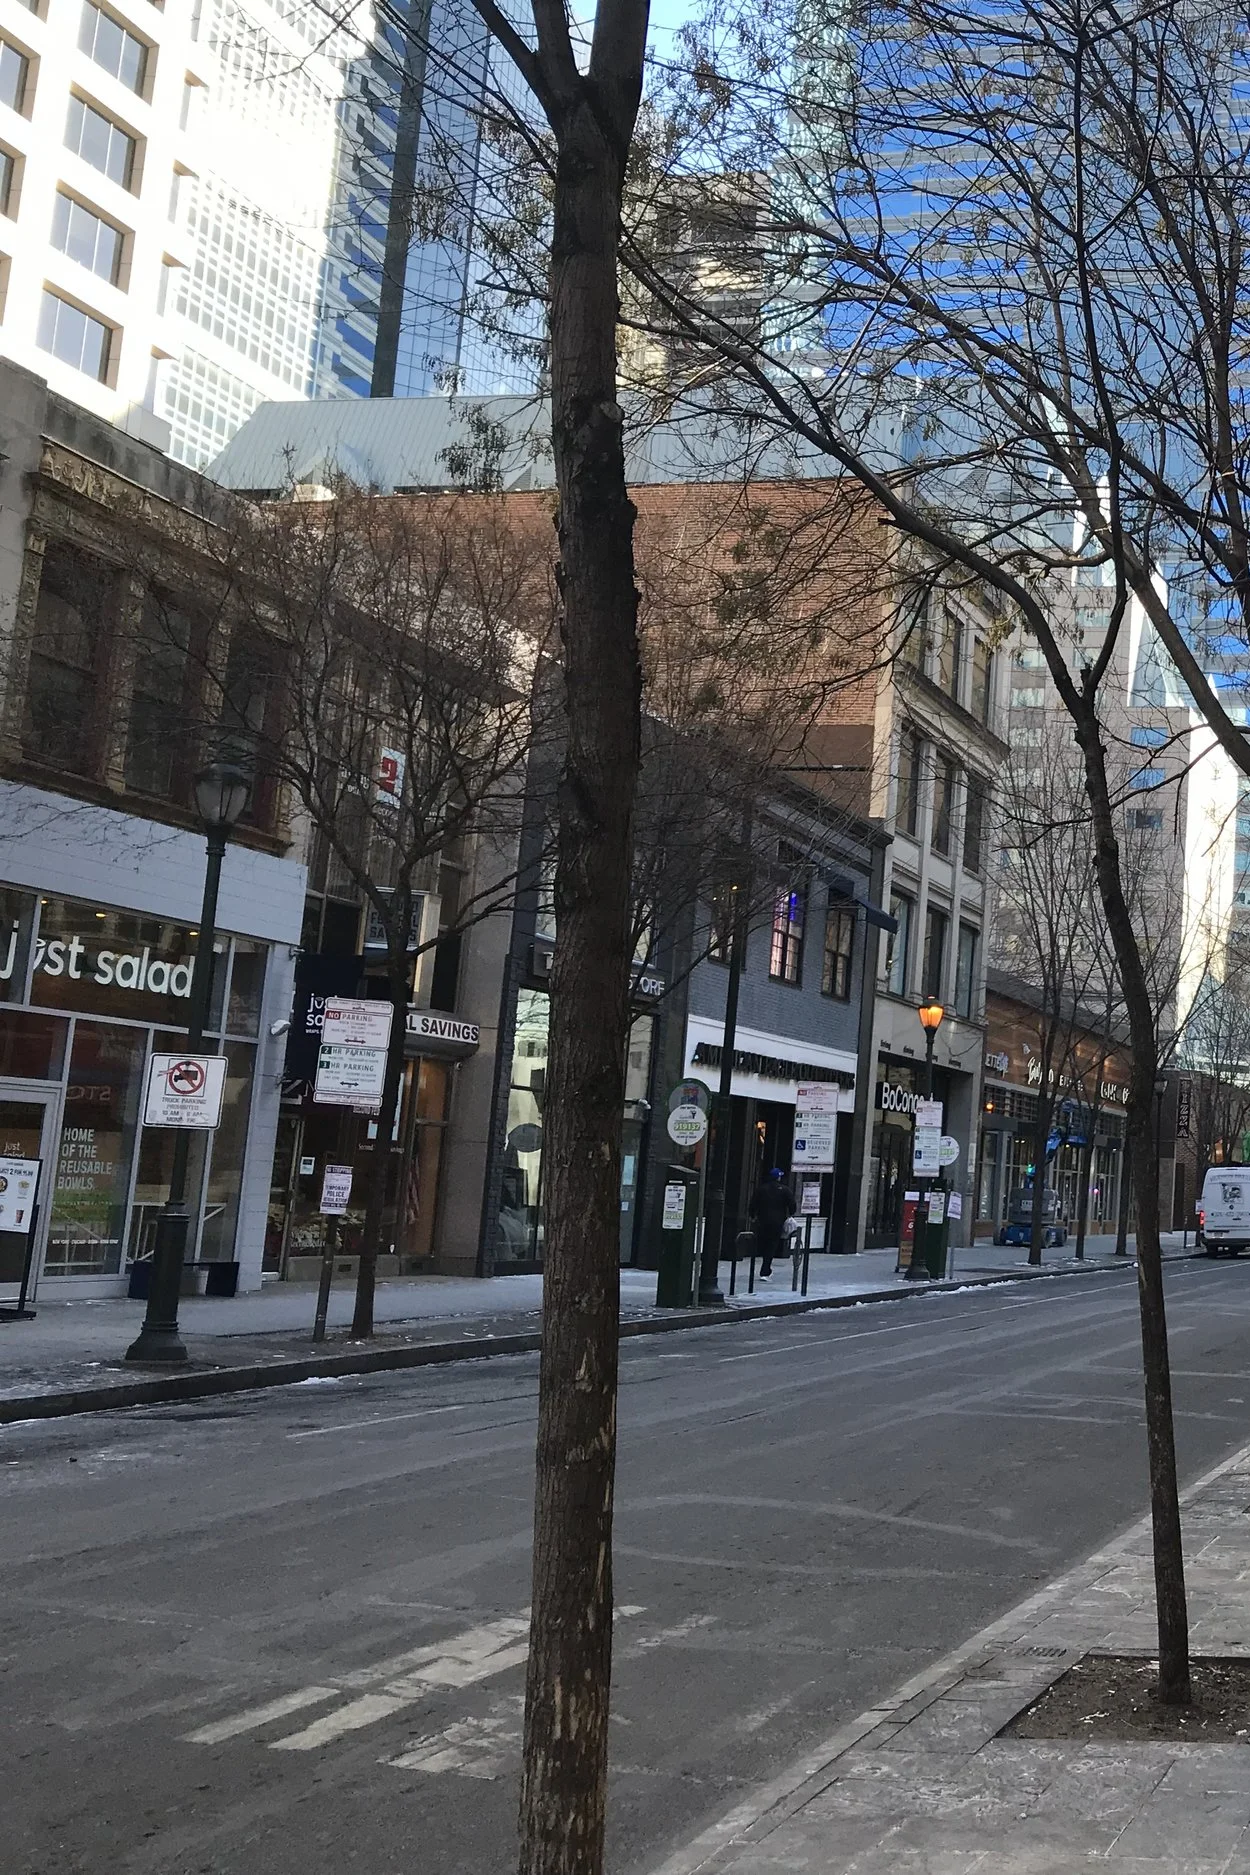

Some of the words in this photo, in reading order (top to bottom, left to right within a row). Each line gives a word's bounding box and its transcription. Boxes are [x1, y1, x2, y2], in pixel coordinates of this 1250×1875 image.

[94, 946, 196, 998] salad
[342, 1013, 373, 1022] PARKING
[421, 1017, 479, 1042] SAVINGS
[345, 1050, 376, 1058] PARKING
[343, 1063, 374, 1072] PARKING
[64, 1127, 95, 1142] HOME
[61, 1144, 76, 1157] OF
[79, 1144, 98, 1158] THE
[59, 1160, 113, 1175] REUSABLE
